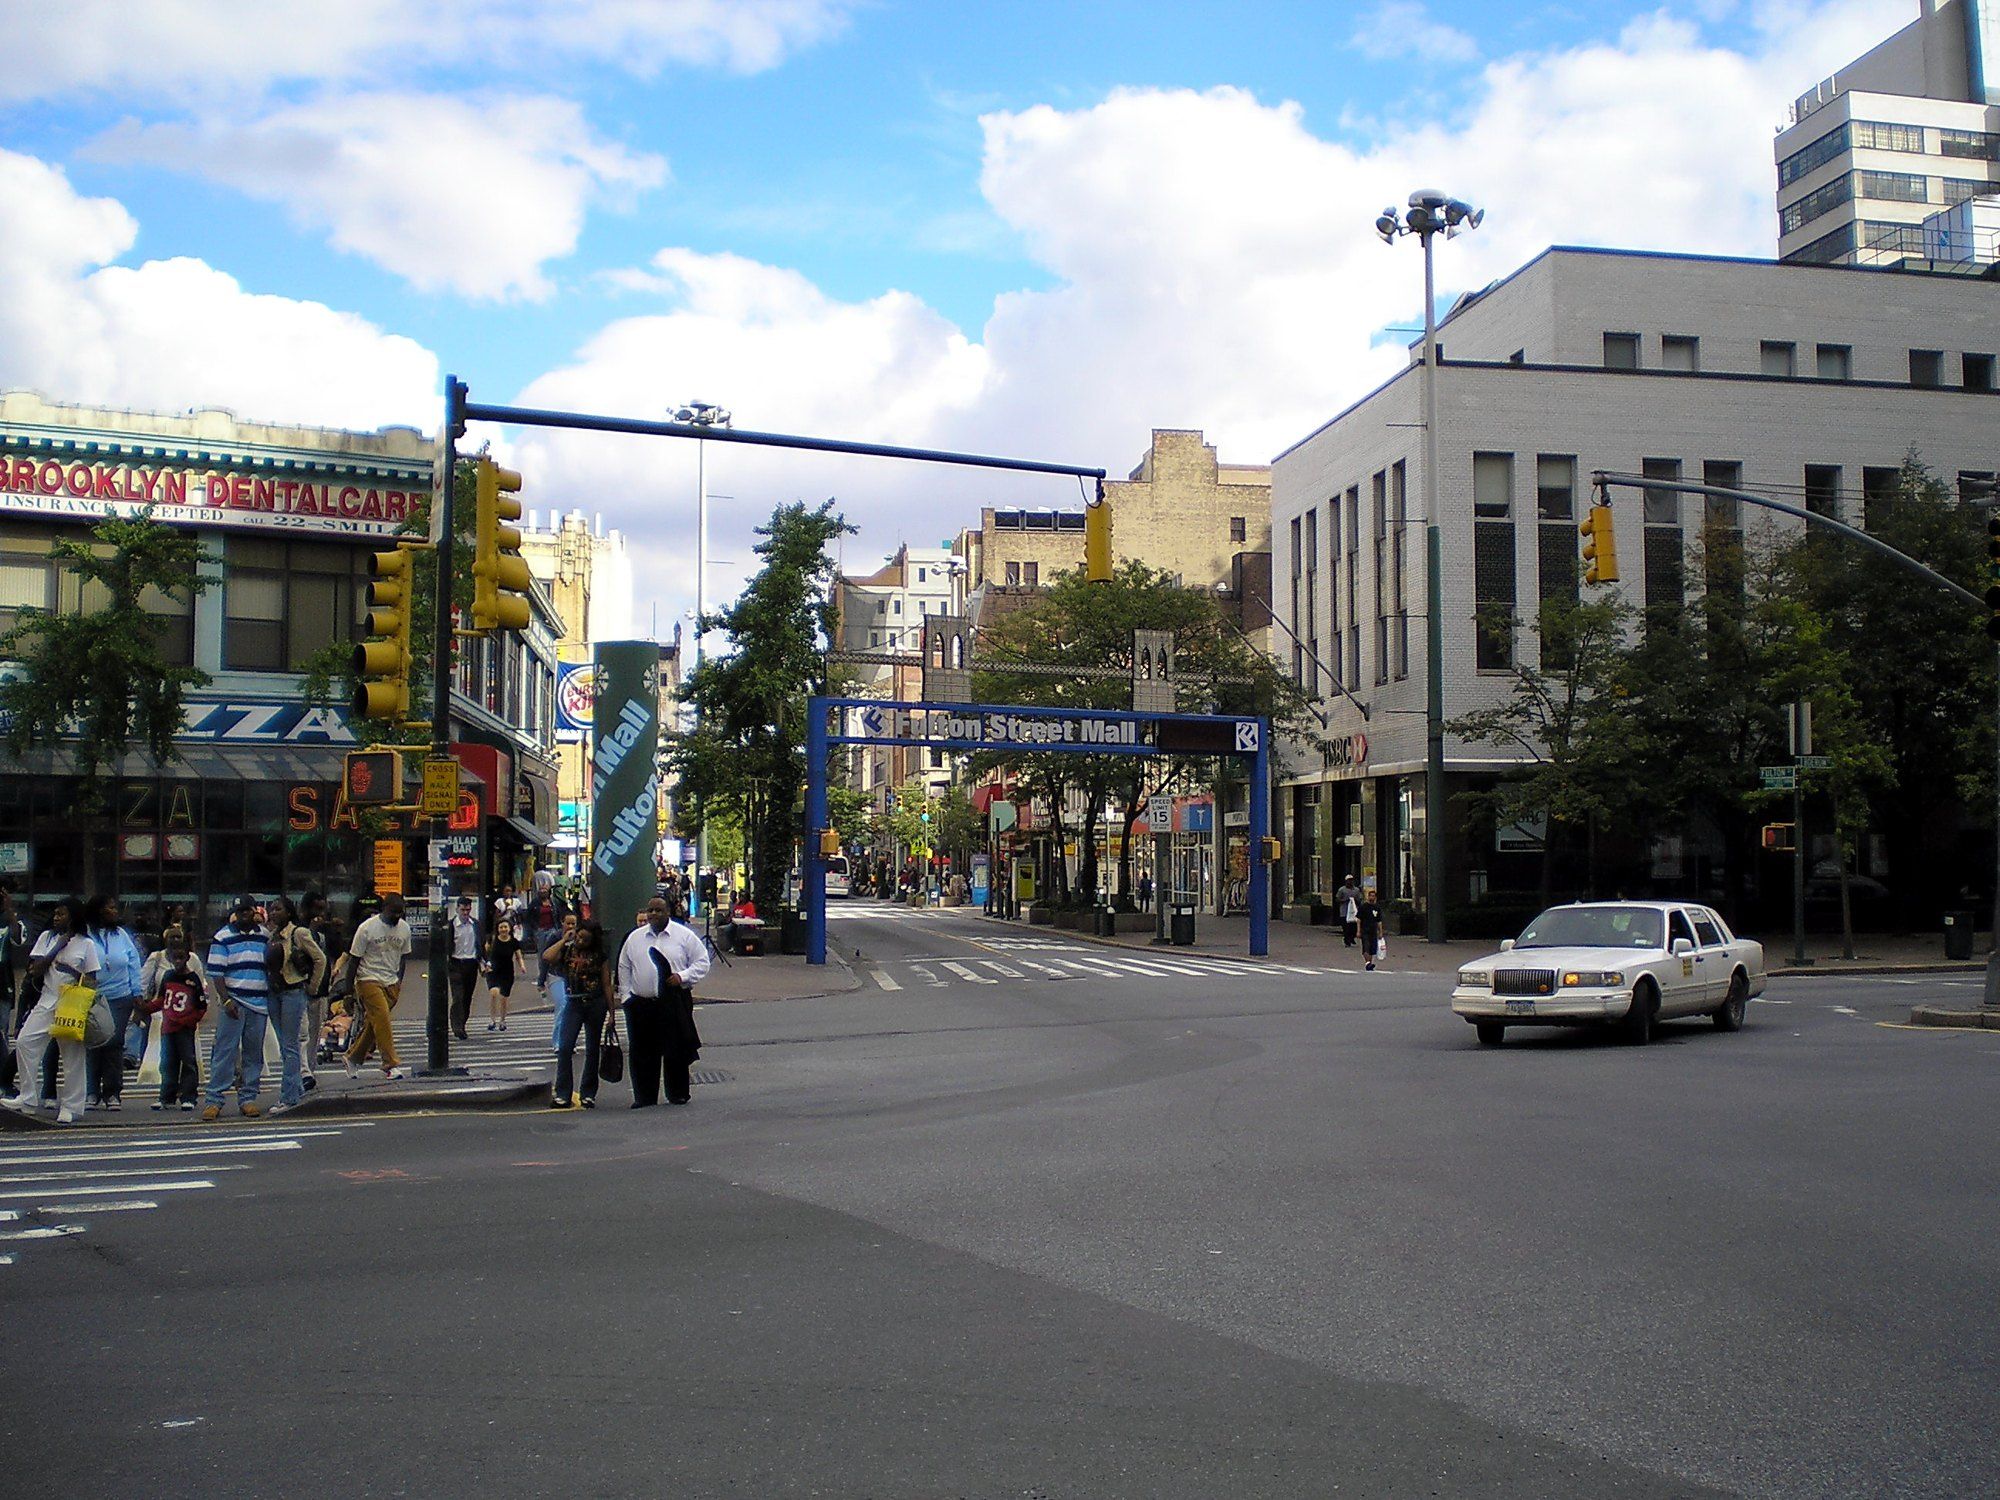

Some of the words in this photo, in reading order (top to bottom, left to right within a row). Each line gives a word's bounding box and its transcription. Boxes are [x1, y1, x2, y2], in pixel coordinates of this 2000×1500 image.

[273, 517, 390, 534] 22-SMIL
[594, 698, 651, 776] Mall
[896, 712, 981, 739] Fulton
[989, 714, 1074, 742] Street
[1080, 719, 1137, 745] Mall
[1323, 736, 1351, 768] HSBC
[426, 765, 454, 773] CROSS
[425, 791, 454, 799] SIGNAL
[594, 773, 658, 877] Fulton
[1153, 812, 1168, 823] 15
[447, 836, 478, 845] SALAD
[452, 844, 472, 854] BAR
[163, 988, 188, 1013] 03
